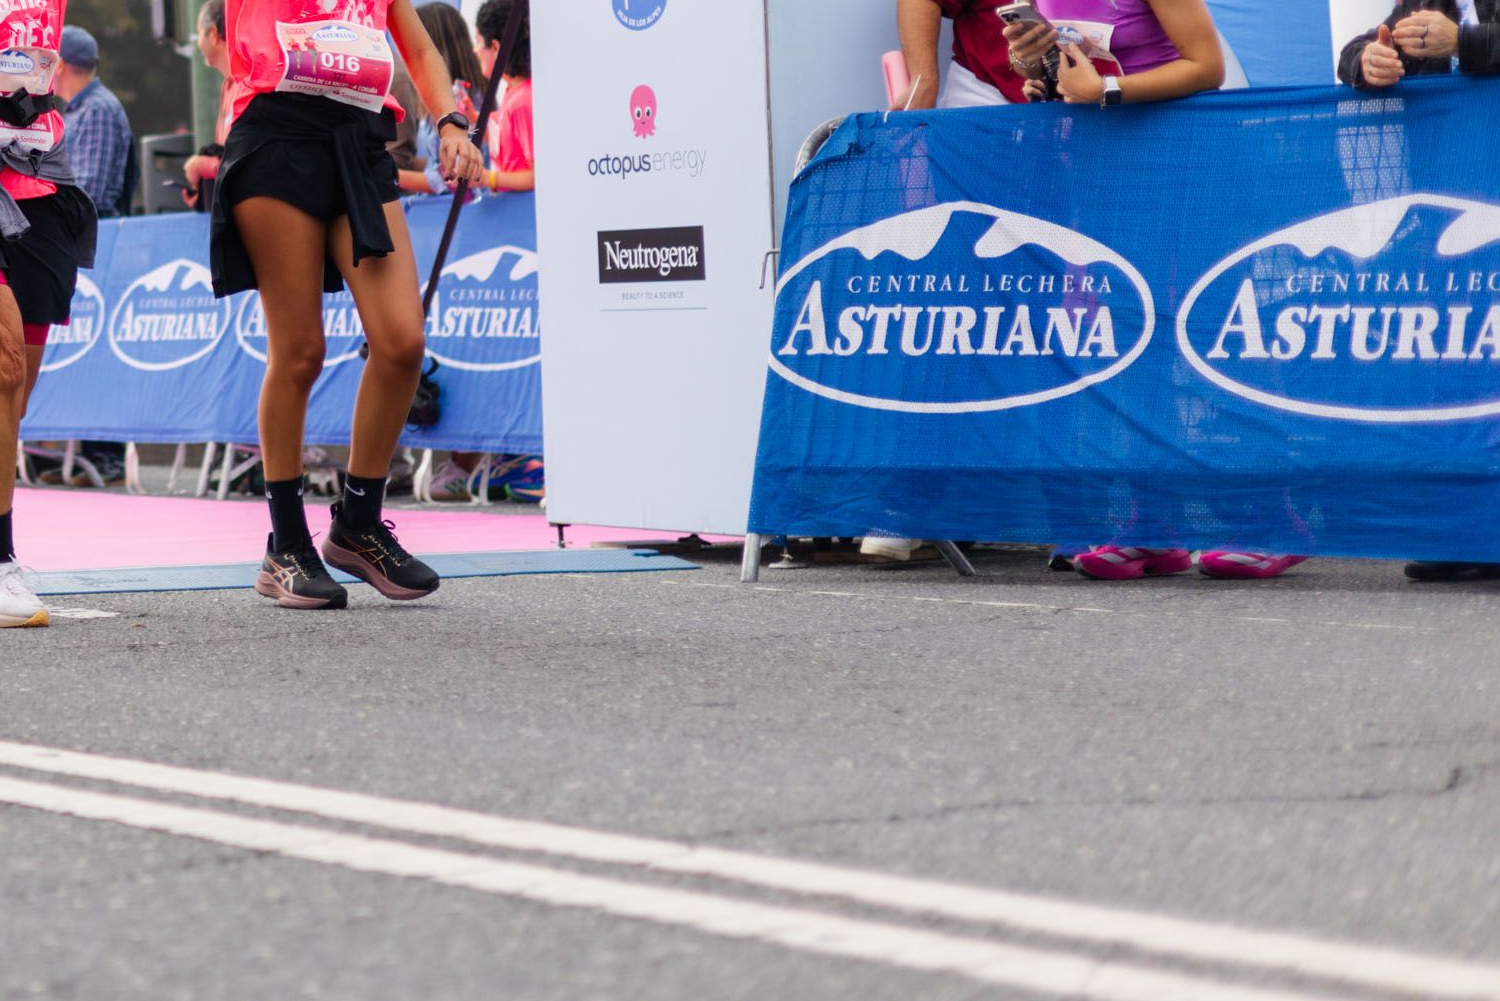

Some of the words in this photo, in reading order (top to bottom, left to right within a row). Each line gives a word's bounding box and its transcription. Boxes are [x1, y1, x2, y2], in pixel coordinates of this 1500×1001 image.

[321, 52, 360, 72] 016
[293, 74, 316, 84] CARRERA
[588, 154, 651, 180] octopus
[652, 150, 707, 178] energy
[604, 241, 699, 276] Neutrogena
[450, 288, 506, 300] CENTRAL
[510, 288, 539, 300] LEC
[847, 274, 971, 294] CENTRAL
[983, 274, 1113, 294] LECHERA
[1286, 271, 1431, 293] CENTRAL
[116, 300, 218, 342] ASTURIANA
[425, 290, 540, 338] ASTURIA
[778, 279, 1120, 357] ASTURIANA
